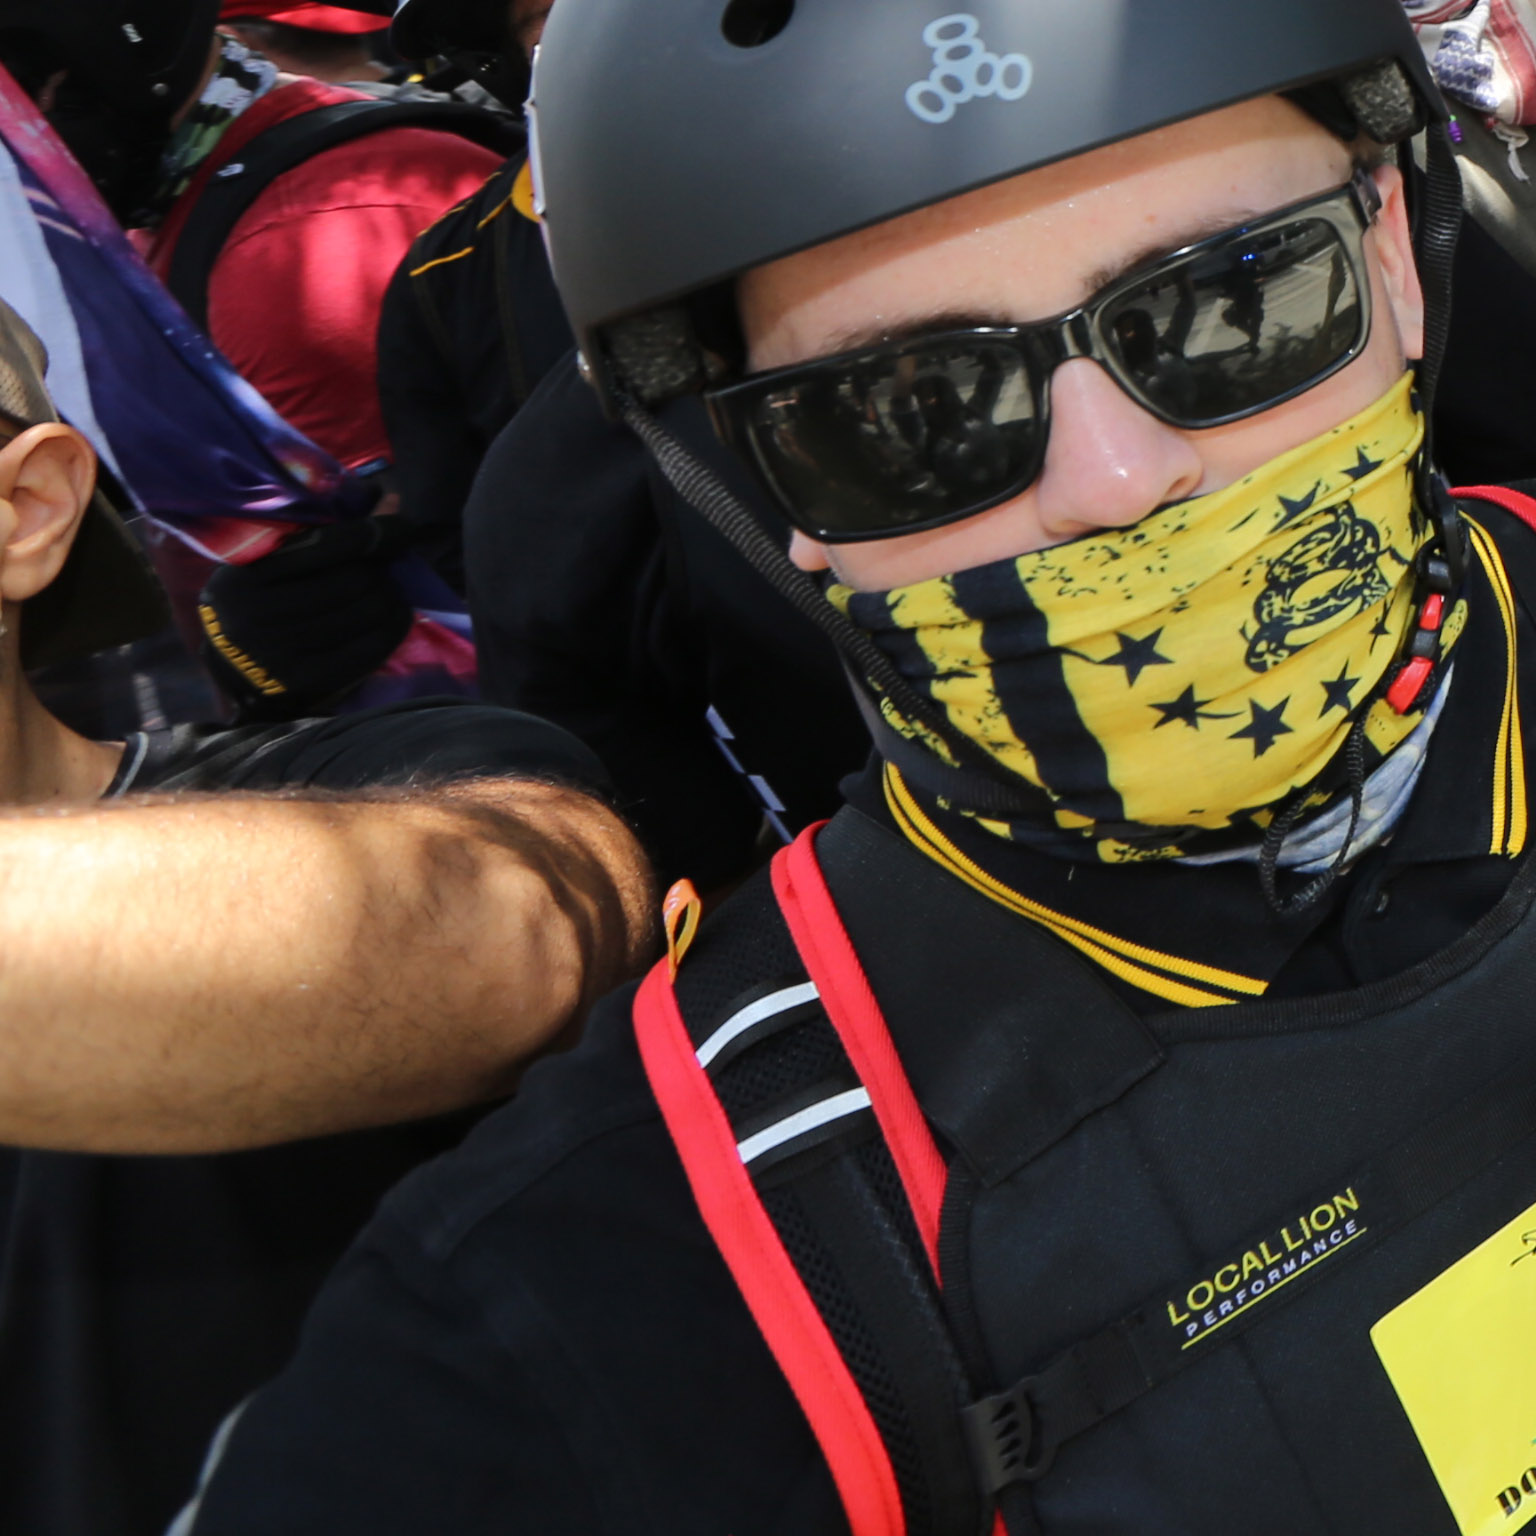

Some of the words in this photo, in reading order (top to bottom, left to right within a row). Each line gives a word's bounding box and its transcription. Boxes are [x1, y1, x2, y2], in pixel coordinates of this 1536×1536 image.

[1167, 1241, 1282, 1327] LOCAL
[1280, 1187, 1359, 1252] LION
[1186, 1219, 1358, 1337] PERFORMANCE
